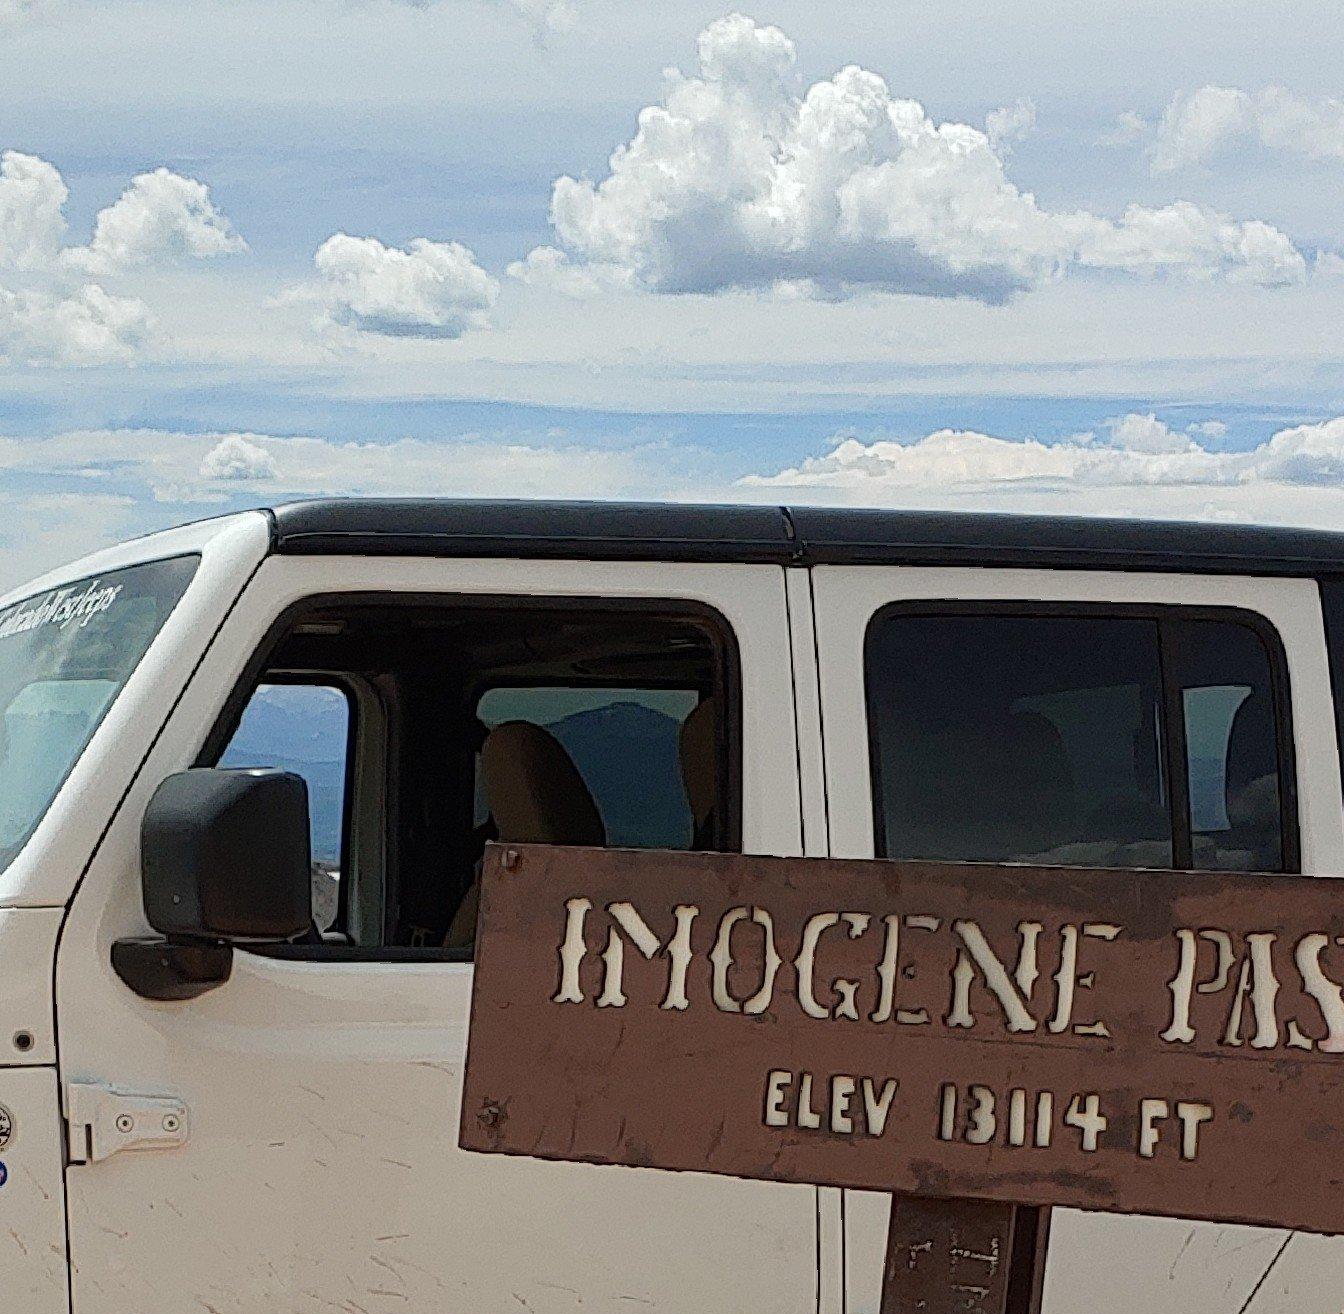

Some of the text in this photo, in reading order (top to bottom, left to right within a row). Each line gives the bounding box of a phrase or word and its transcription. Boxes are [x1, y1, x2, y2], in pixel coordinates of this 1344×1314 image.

[552, 897, 1124, 1039] IMOGENE
[764, 1069, 1215, 1161] ELEV 13114 FT
